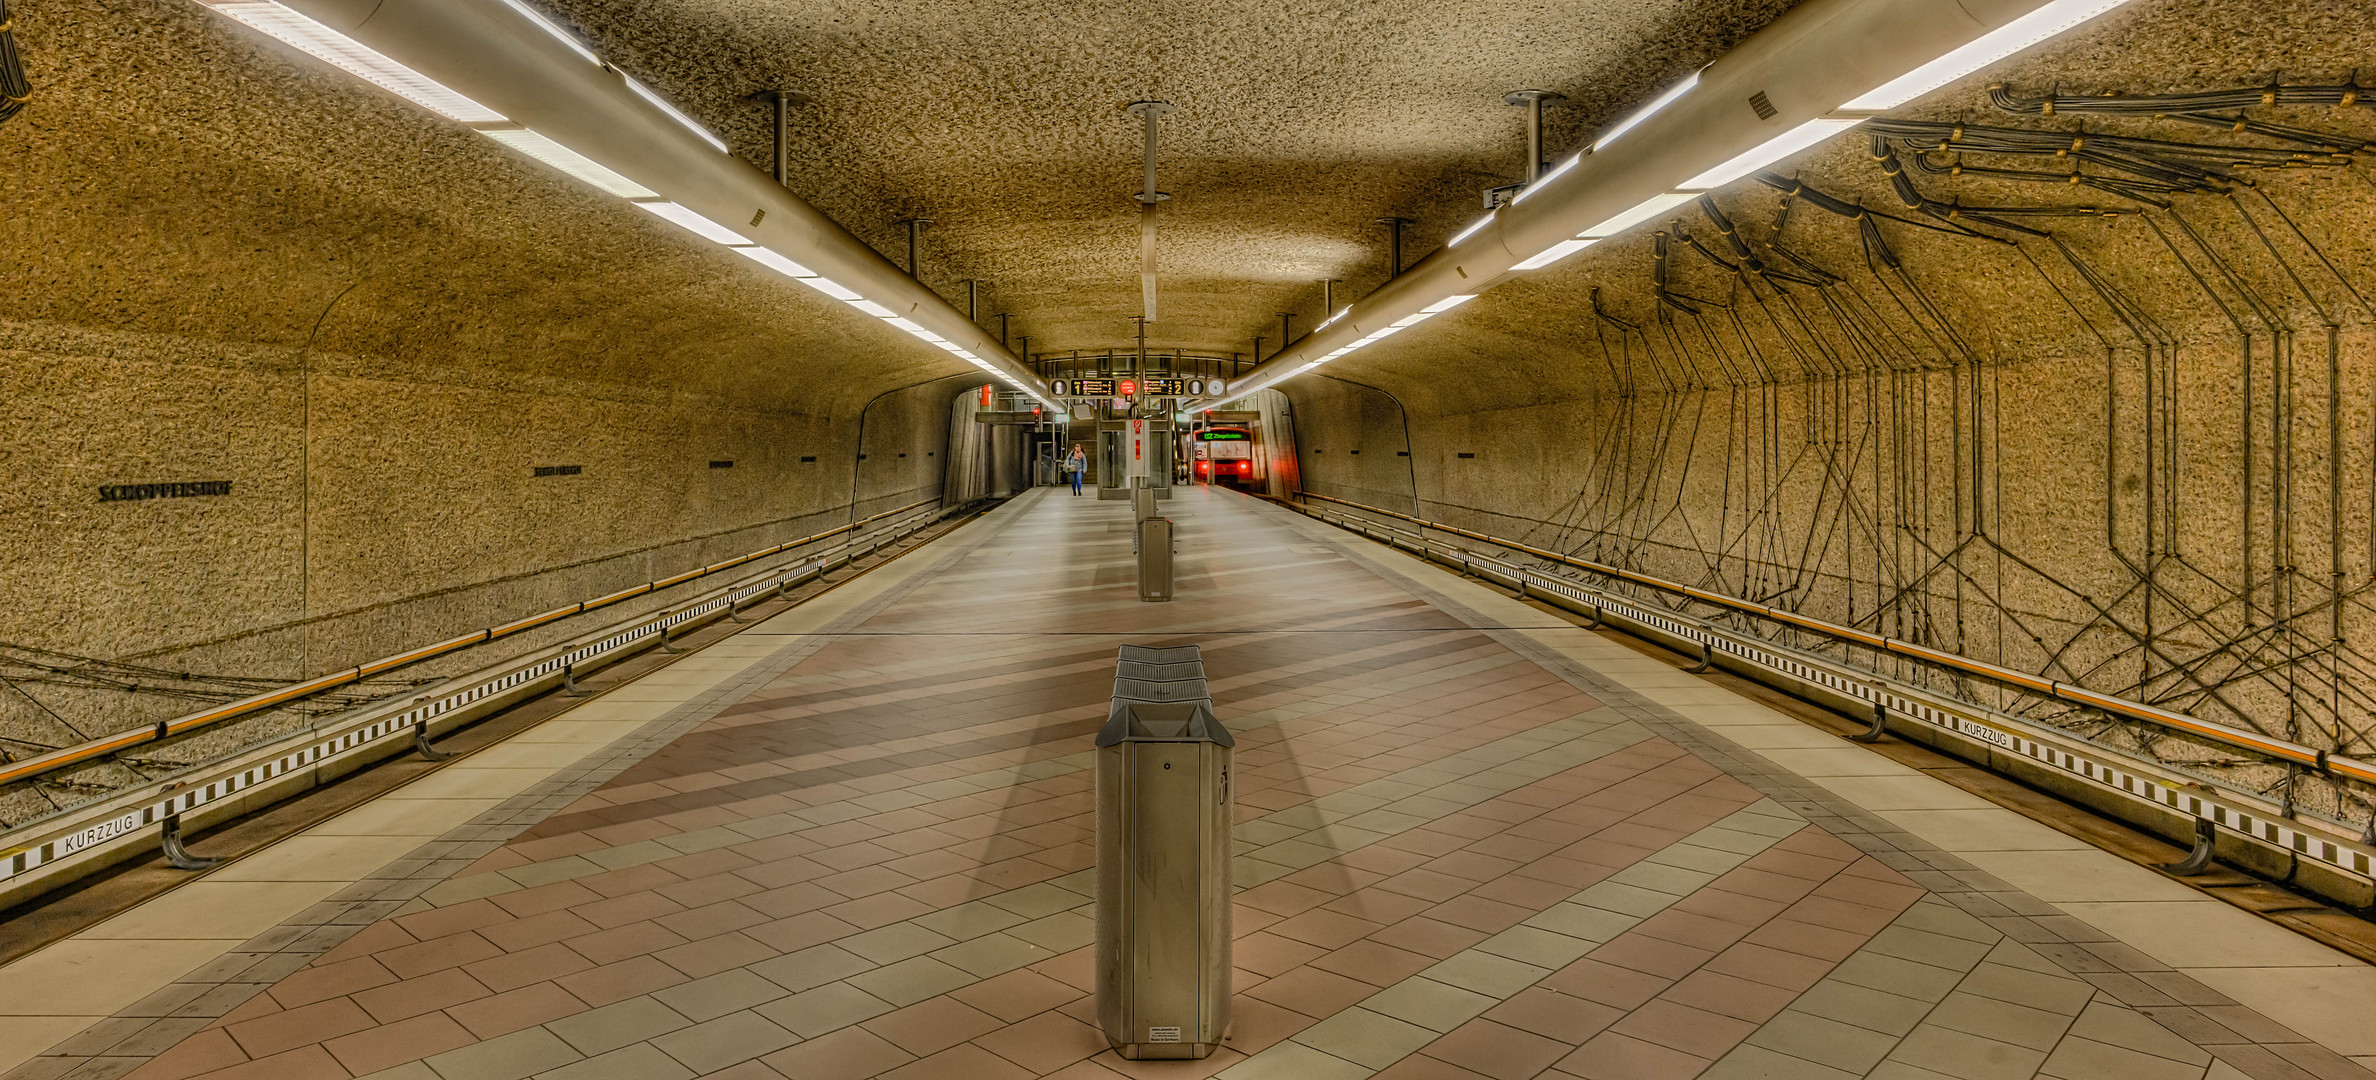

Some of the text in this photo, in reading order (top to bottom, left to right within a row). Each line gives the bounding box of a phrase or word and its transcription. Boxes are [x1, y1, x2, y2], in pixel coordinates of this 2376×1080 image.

[1075, 385, 1080, 395] 1
[1174, 384, 1182, 395] 2
[98, 480, 233, 502] SCHOPPERSHOF
[1964, 721, 2007, 746] KURZZUG
[65, 815, 133, 853] KURZZUG
